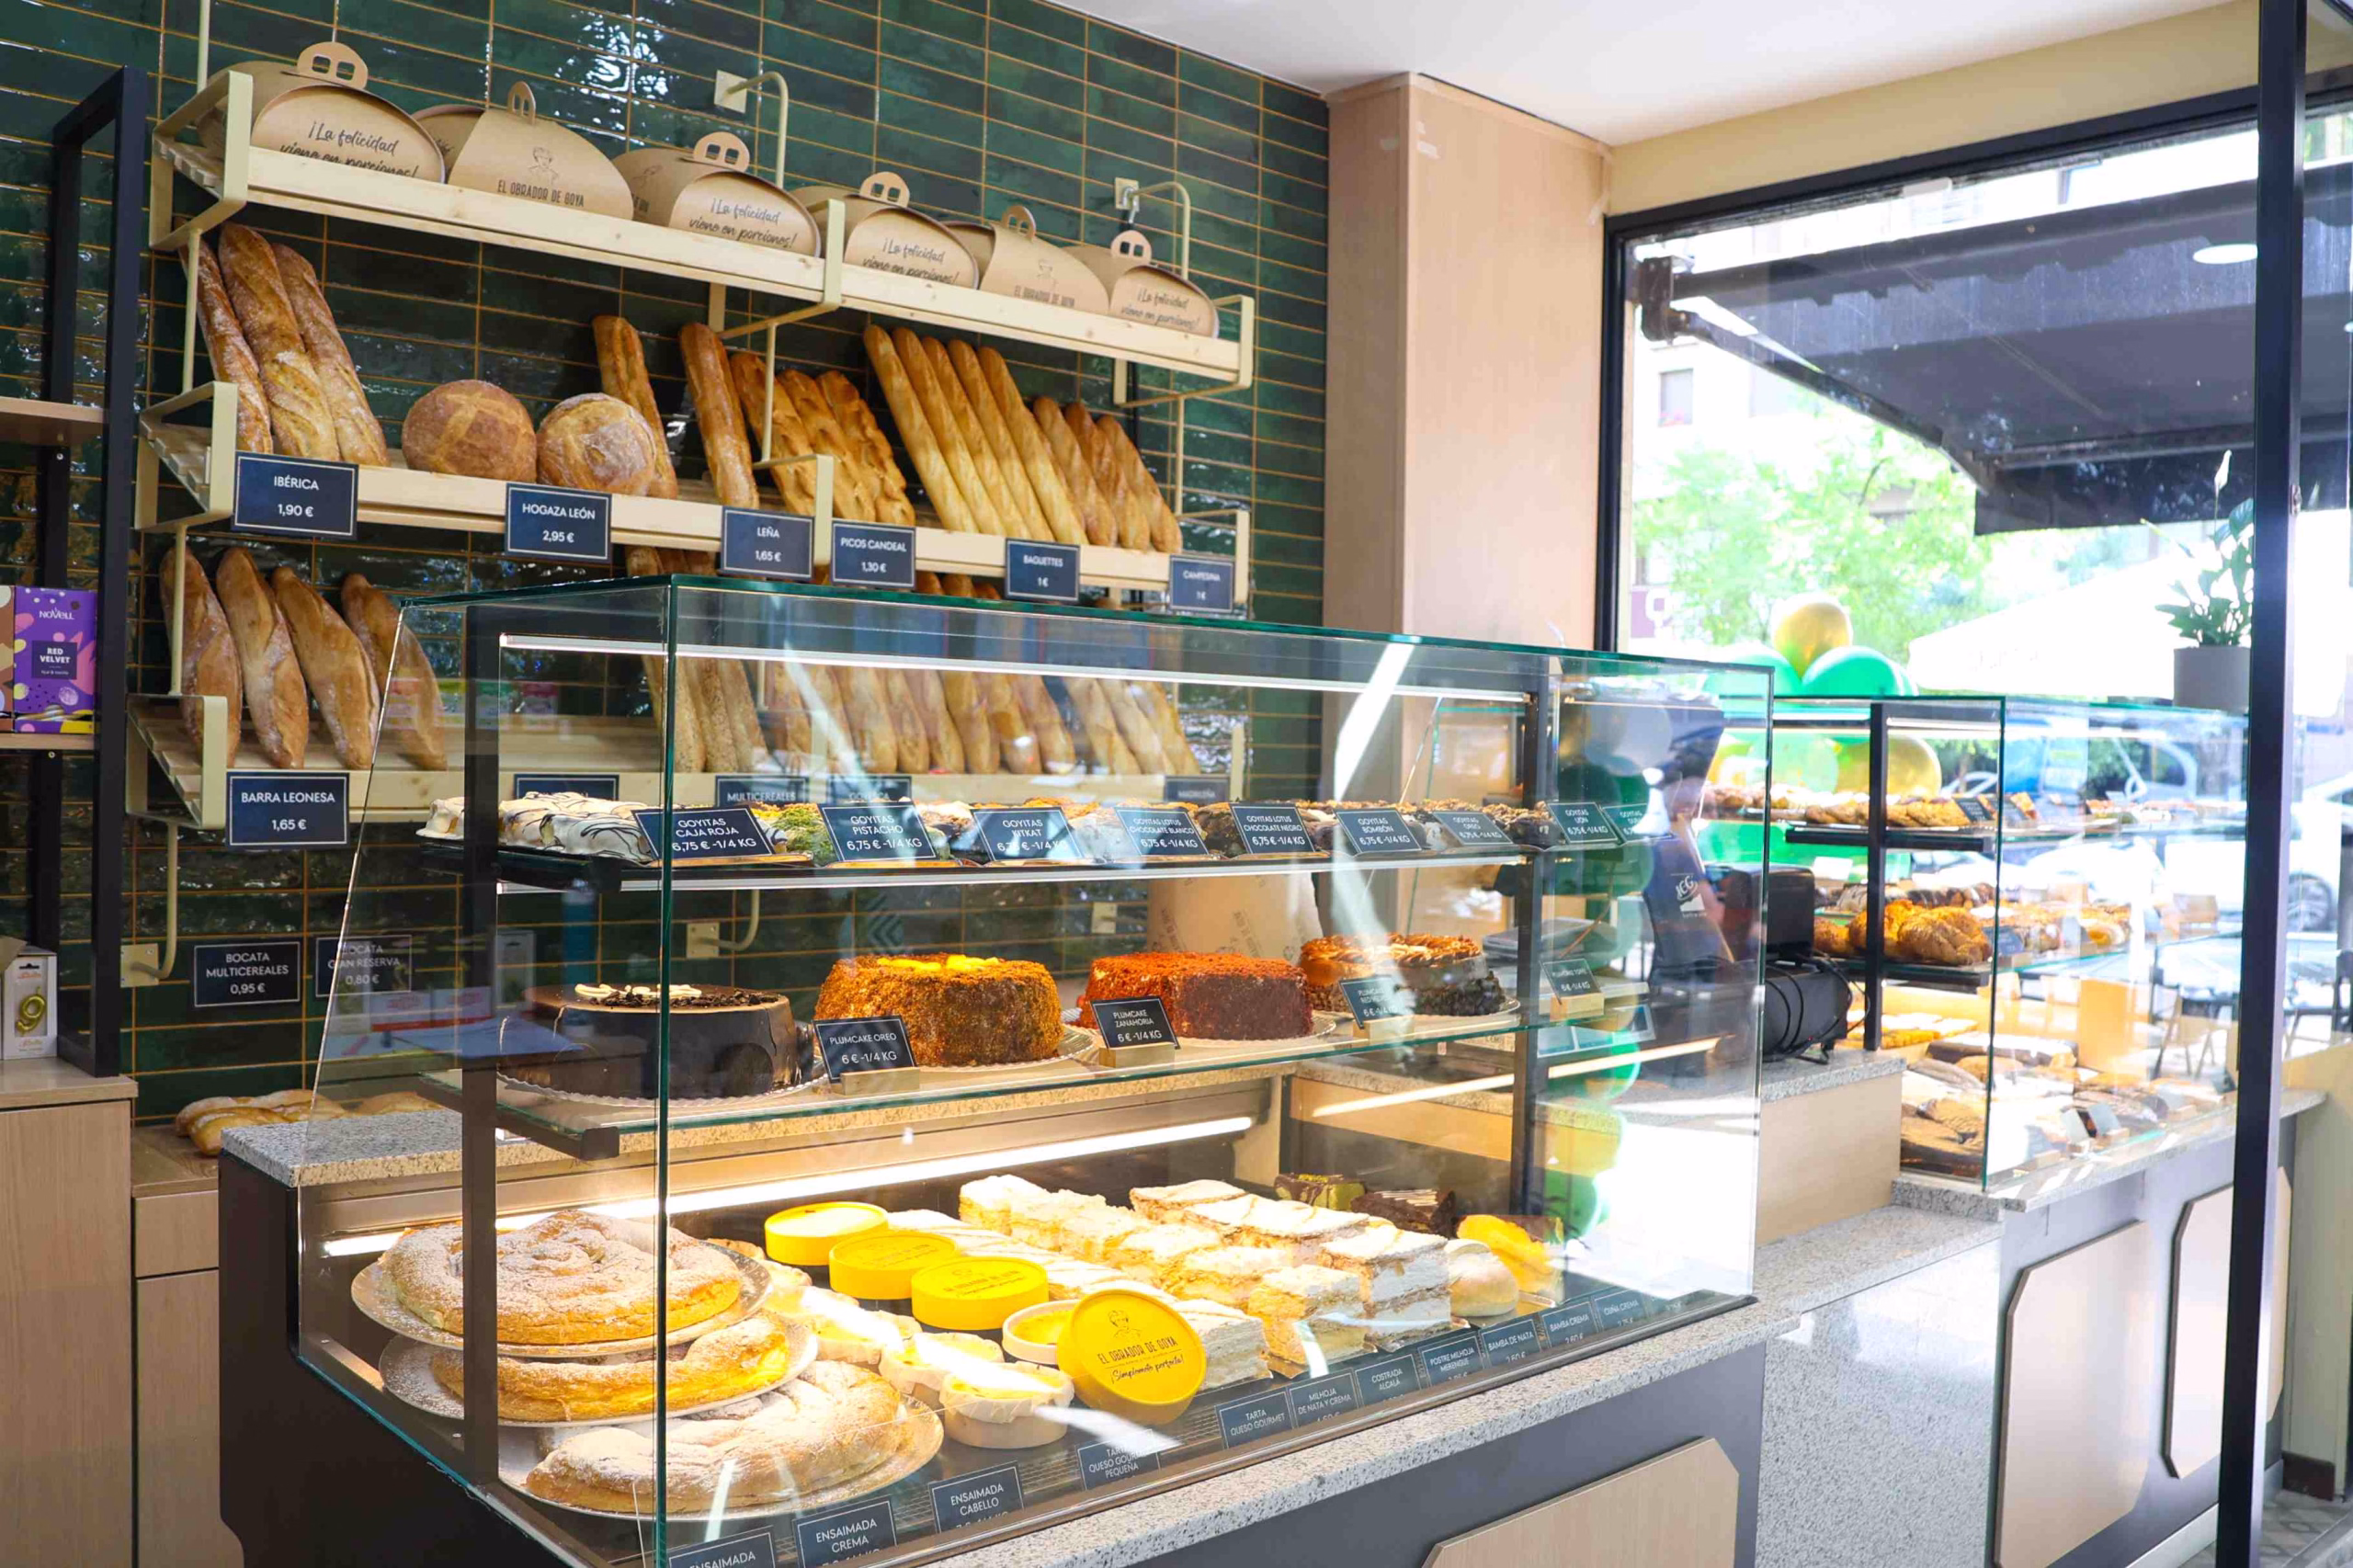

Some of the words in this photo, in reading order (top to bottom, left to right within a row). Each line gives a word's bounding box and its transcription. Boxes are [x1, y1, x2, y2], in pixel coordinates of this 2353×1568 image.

[308, 122, 335, 142] ¡La
[337, 124, 399, 156] felicidad
[497, 179, 506, 194] EL
[510, 182, 549, 201] OBRADOR
[551, 189, 562, 202] DE
[733, 199, 781, 226] felicidad
[689, 216, 721, 233] viene
[722, 225, 736, 236] en
[738, 227, 798, 250] porciones!
[273, 474, 319, 491] IBÉRICA
[277, 503, 302, 517] 1,90
[303, 505, 314, 517] €
[522, 503, 566, 517] HOGAZA
[568, 505, 597, 520] LEÓN
[542, 530, 566, 543] 2,95
[566, 531, 575, 543] €
[756, 526, 780, 540] LEÑA
[841, 537, 867, 551] PICOS
[868, 539, 907, 553] CANDEAL
[755, 550, 773, 562] 1,65
[773, 551, 782, 562] €
[1023, 554, 1063, 568] BAGUETTES
[861, 561, 879, 573] 1,30
[879, 562, 887, 573] €
[47, 647, 63, 655] RED
[40, 655, 71, 664] VELVET
[241, 792, 280, 804] BARRA
[283, 792, 335, 804] LEONESA
[727, 791, 796, 802] MULTICEREALES
[272, 819, 296, 831] 1,65
[298, 819, 307, 830] €
[678, 818, 726, 829] GOYITAS
[850, 814, 894, 824] GOYITAS
[1002, 819, 1043, 828] GOYITAS
[1133, 817, 1161, 826] GOYITAS
[1161, 818, 1181, 826] LOTUS
[1246, 814, 1273, 824] GOYITAS
[1273, 815, 1292, 824] LOTUS
[1358, 817, 1389, 826] GOYITAS
[676, 828, 707, 838] CAJA
[708, 827, 740, 836] ROJA
[853, 824, 904, 835] PISTACHO
[1011, 828, 1041, 837] KITKAT
[1130, 825, 1169, 835] CHOCOLATE
[1169, 825, 1195, 835] BLANCO
[1244, 824, 1279, 833] CHOCOLATE
[1280, 824, 1303, 833] NEGRO
[1362, 824, 1394, 834] BOMBÓN
[672, 842, 699, 853] 6,75
[700, 840, 710, 850] €
[738, 837, 757, 847] KG
[847, 839, 870, 851] 6,75
[871, 838, 881, 849] €
[905, 837, 923, 847] KG
[1021, 840, 1031, 851] €
[1140, 837, 1161, 848] 6,75
[1161, 837, 1168, 847] €
[1184, 838, 1199, 848] KG
[1252, 835, 1270, 846] 6,75
[1270, 836, 1277, 846] €
[1292, 835, 1305, 846] KG
[1359, 836, 1377, 846] 6,75
[1398, 835, 1411, 844] KG
[226, 952, 269, 963] BOCATA
[327, 959, 354, 969] GAN
[357, 957, 401, 968] RESERVA
[206, 964, 290, 979] MULTICEREALES
[346, 974, 370, 986] 0,80
[371, 974, 381, 985] €
[230, 983, 255, 995] 0,95
[257, 983, 266, 994] €
[1113, 1009, 1148, 1019] PLUMCAKE
[1115, 1017, 1154, 1028] ZANAHORIA
[830, 1035, 872, 1046] PLUMCAKE
[873, 1032, 897, 1042] OREO
[1116, 1032, 1123, 1042] 6
[1124, 1032, 1131, 1042] €
[1149, 1029, 1163, 1040] KG
[842, 1054, 849, 1064] 6
[850, 1054, 859, 1064] €
[881, 1051, 897, 1062] KG
[1620, 1300, 1640, 1312] CREMA
[1550, 1319, 1570, 1332] BAMBA
[1569, 1313, 1589, 1326] CREMA
[1488, 1338, 1509, 1352] BAMBA
[1508, 1335, 1518, 1346] DE
[1518, 1332, 1534, 1345] NATA
[1097, 1352, 1109, 1364] EL
[1108, 1344, 1146, 1361] OBRADOR
[1145, 1341, 1158, 1353] DE
[1158, 1335, 1179, 1349] GOYA
[1429, 1353, 1451, 1367] POSTRE
[1450, 1346, 1475, 1362] MILHOJA
[1440, 1358, 1471, 1372] MERENGUE
[1371, 1368, 1404, 1383] COSTRADA
[1379, 1377, 1401, 1392] ALCALÁ
[1308, 1387, 1337, 1402] MILHOJA
[1298, 1404, 1308, 1415] DE
[1307, 1400, 1325, 1414] NATA
[1324, 1399, 1330, 1408] Y
[1329, 1393, 1352, 1407] CREMA
[1245, 1409, 1267, 1422] TARTA
[1230, 1423, 1254, 1437] QUESO
[1253, 1412, 1286, 1430] GOURMET
[1106, 1444, 1127, 1458] TAR
[1088, 1457, 1115, 1474] QUESO
[1115, 1449, 1147, 1467] GOUR
[1105, 1462, 1140, 1479] PEQUEÑA
[950, 1483, 1005, 1506] ENSAIMADA
[959, 1497, 1000, 1517] CABELLO
[815, 1518, 878, 1543] ENSAIMADA
[831, 1535, 870, 1554] CREMA
